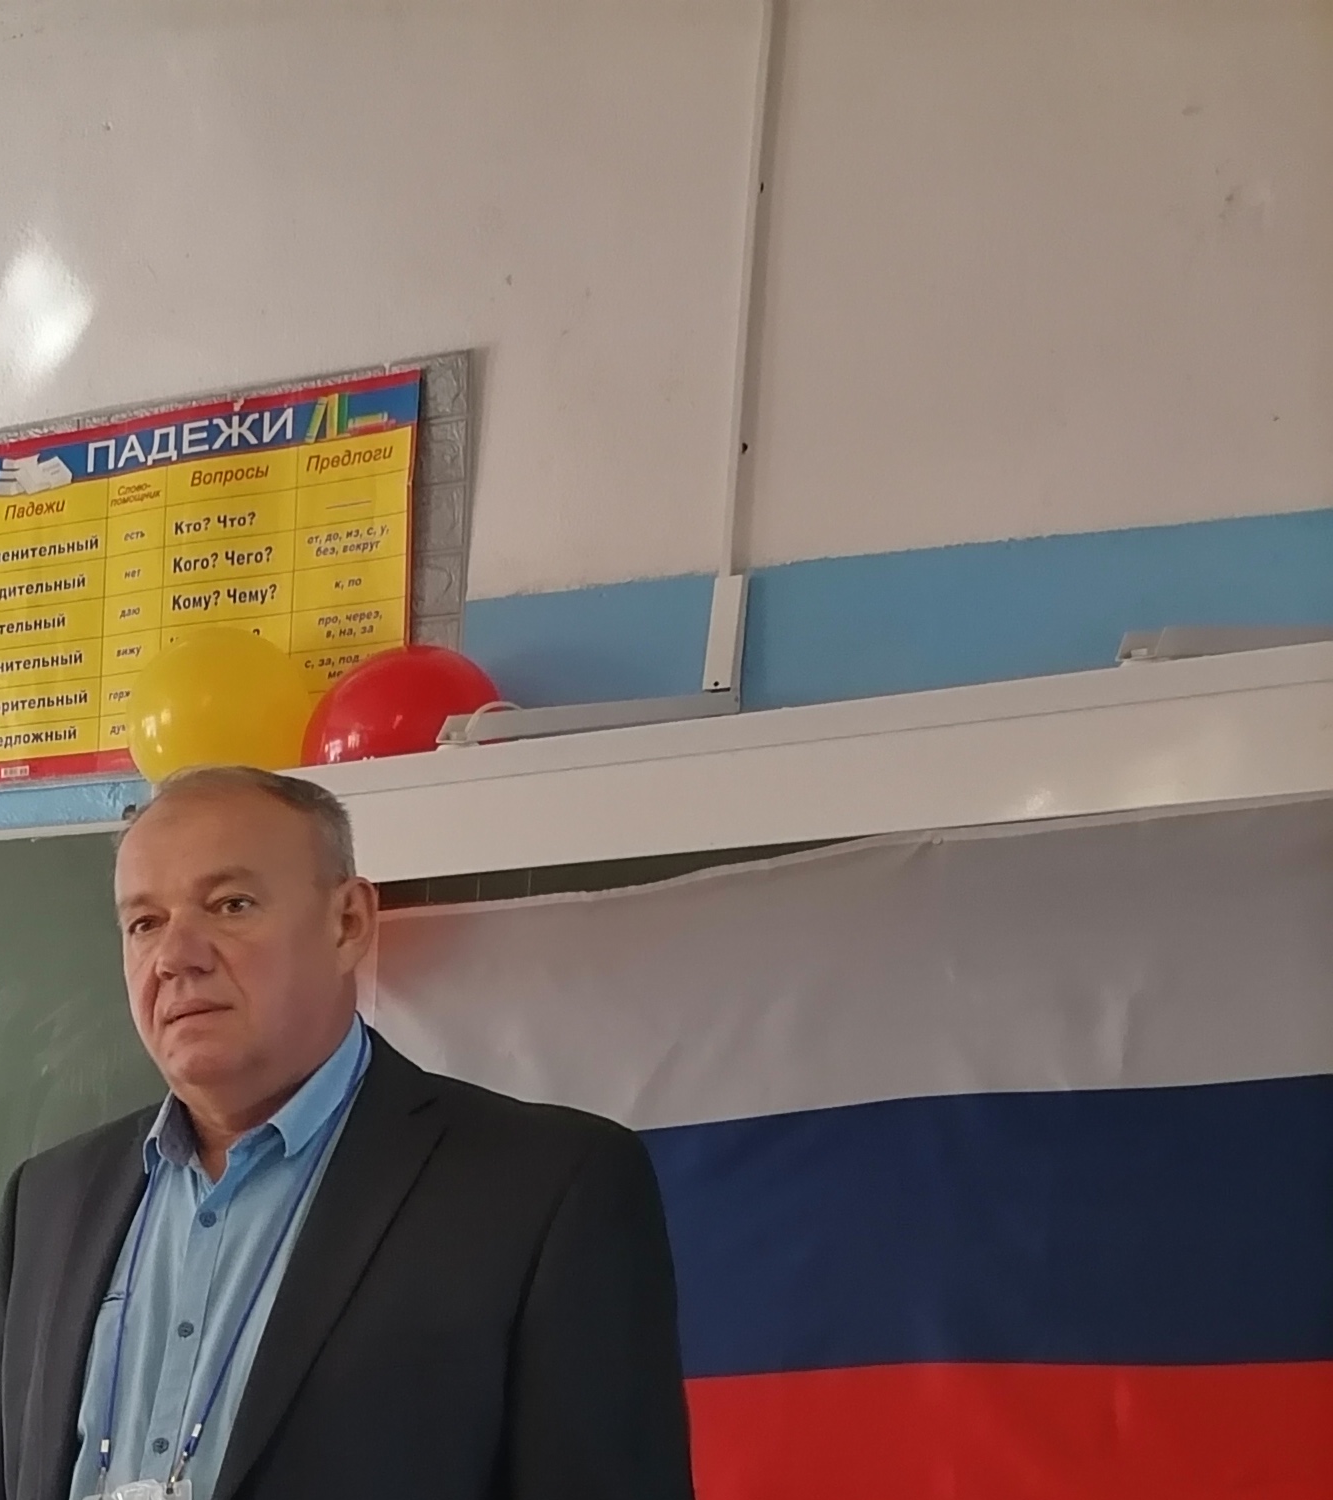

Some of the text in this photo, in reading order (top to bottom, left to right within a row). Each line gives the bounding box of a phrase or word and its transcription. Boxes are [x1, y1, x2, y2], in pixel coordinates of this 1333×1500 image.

[86, 406, 294, 473] ПАДЕЖИ
[306, 446, 393, 474] Предлоги
[190, 465, 269, 487] Вопросы
[117, 481, 152, 496] Слово-
[110, 489, 161, 507] помощник
[4, 498, 65, 521] Падежи
[174, 511, 256, 535] Кто? Что?
[123, 530, 145, 542] есть
[315, 539, 380, 557] без, вокруг
[173, 546, 273, 574] Кого? Чего?
[124, 568, 141, 580] нет
[347, 577, 362, 587] по
[172, 583, 277, 611] Кому? Чему?
[119, 607, 140, 619] даю
[317, 609, 383, 627] про, через,
[360, 624, 374, 634] за
[116, 645, 142, 658] вижу
